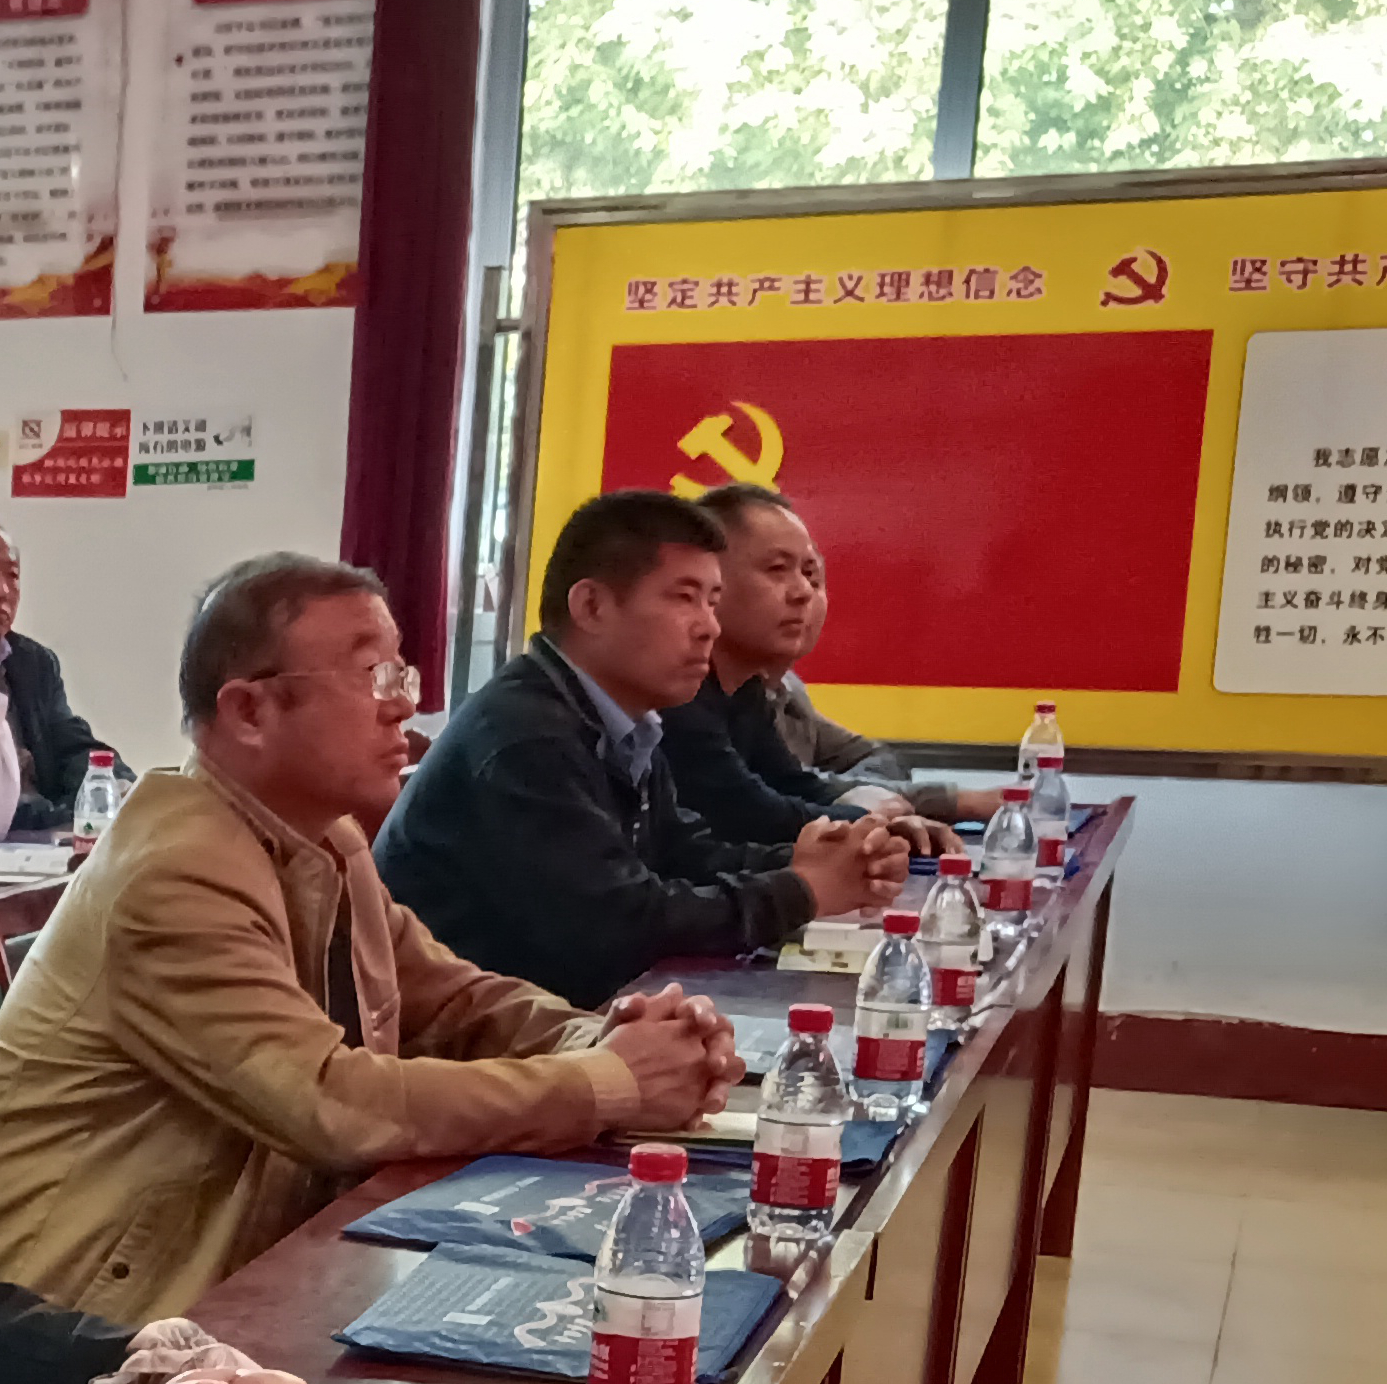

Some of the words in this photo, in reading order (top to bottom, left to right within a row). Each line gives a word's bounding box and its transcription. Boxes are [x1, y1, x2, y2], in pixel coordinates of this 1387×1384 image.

[1229, 254, 1387, 292] 坚守共
[625, 266, 1043, 310] 坚定共产主义理想信念
[1313, 447, 1387, 467] 我志愿
[1267, 483, 1387, 504] 纲领，遵守
